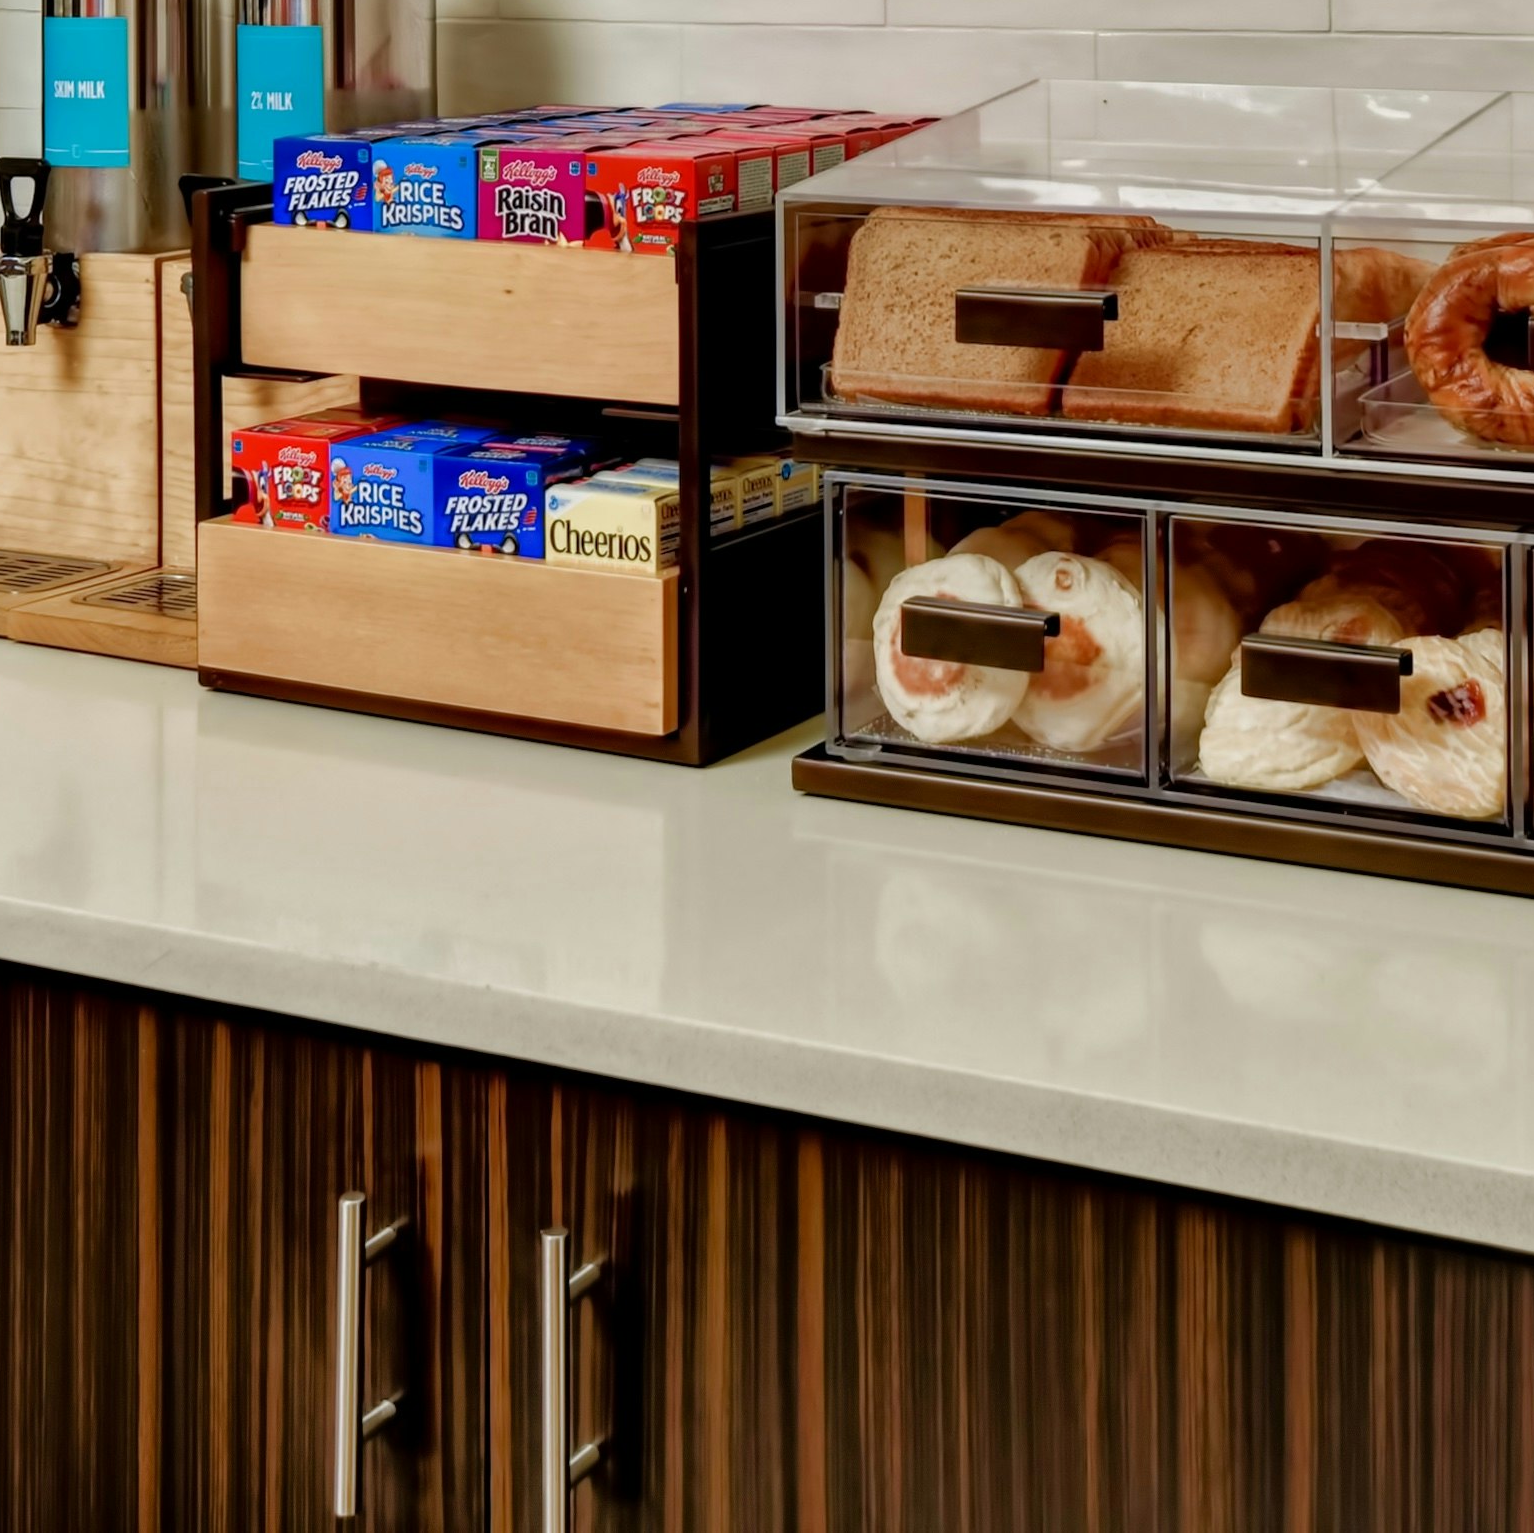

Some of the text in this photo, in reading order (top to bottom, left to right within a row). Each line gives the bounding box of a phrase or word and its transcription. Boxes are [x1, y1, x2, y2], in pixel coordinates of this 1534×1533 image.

[54, 80, 105, 99] SKIM MILK
[250, 91, 293, 111] 2% MILK
[296, 150, 343, 173] Kellogg's
[502, 159, 558, 186] Kellogg's
[283, 171, 360, 195] FROSTED
[637, 166, 681, 185] Kellogg's
[288, 189, 352, 212] FLAKES
[400, 181, 445, 205] RICE
[495, 185, 566, 219] Raisin
[631, 186, 686, 207] FROOT
[382, 203, 464, 231] KRISPIES
[635, 204, 684, 224] LOOPS
[502, 211, 559, 241] Bran
[273, 466, 322, 486] FROOT
[458, 469, 511, 494] Kellogg's
[276, 482, 321, 503] LOOPS
[358, 481, 404, 508] RICE
[445, 493, 528, 515] FROSTED
[340, 502, 424, 534] KRISPIES
[450, 512, 521, 534] FLAKES
[549, 518, 652, 563] Cheerios
